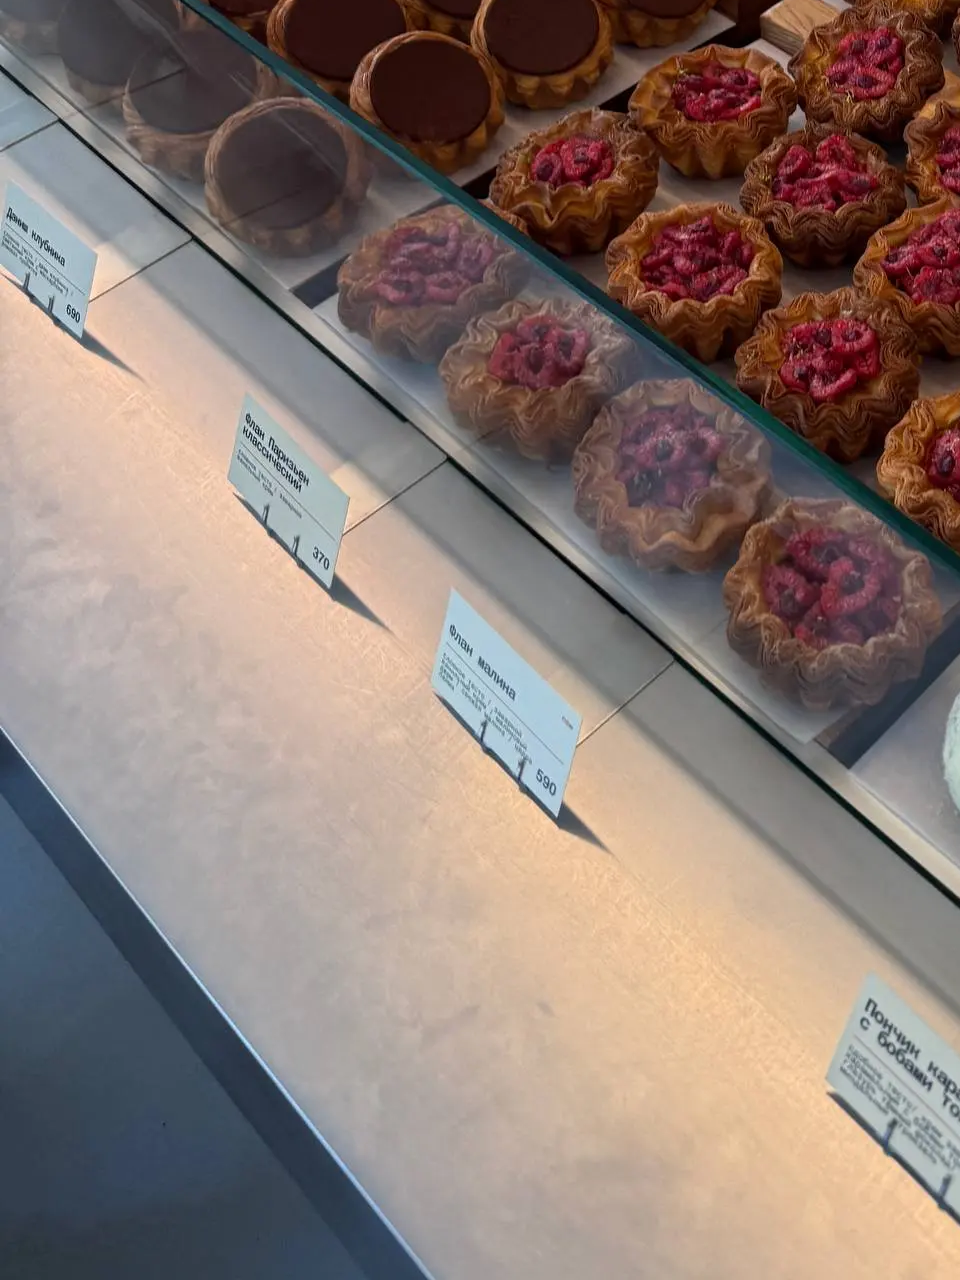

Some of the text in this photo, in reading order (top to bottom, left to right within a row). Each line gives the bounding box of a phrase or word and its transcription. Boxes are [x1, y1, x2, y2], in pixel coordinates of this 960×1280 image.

[31, 228, 66, 267] клубника
[66, 304, 81, 324] 690
[242, 426, 302, 494] классический
[245, 412, 265, 440] Флан
[268, 436, 310, 487] Паризьен
[312, 546, 330, 571] 370
[449, 623, 516, 701] Флан малина
[536, 769, 557, 797] 590
[859, 1015, 871, 1032] с
[877, 1031, 934, 1092] бобами
[864, 998, 921, 1059] Пончик
